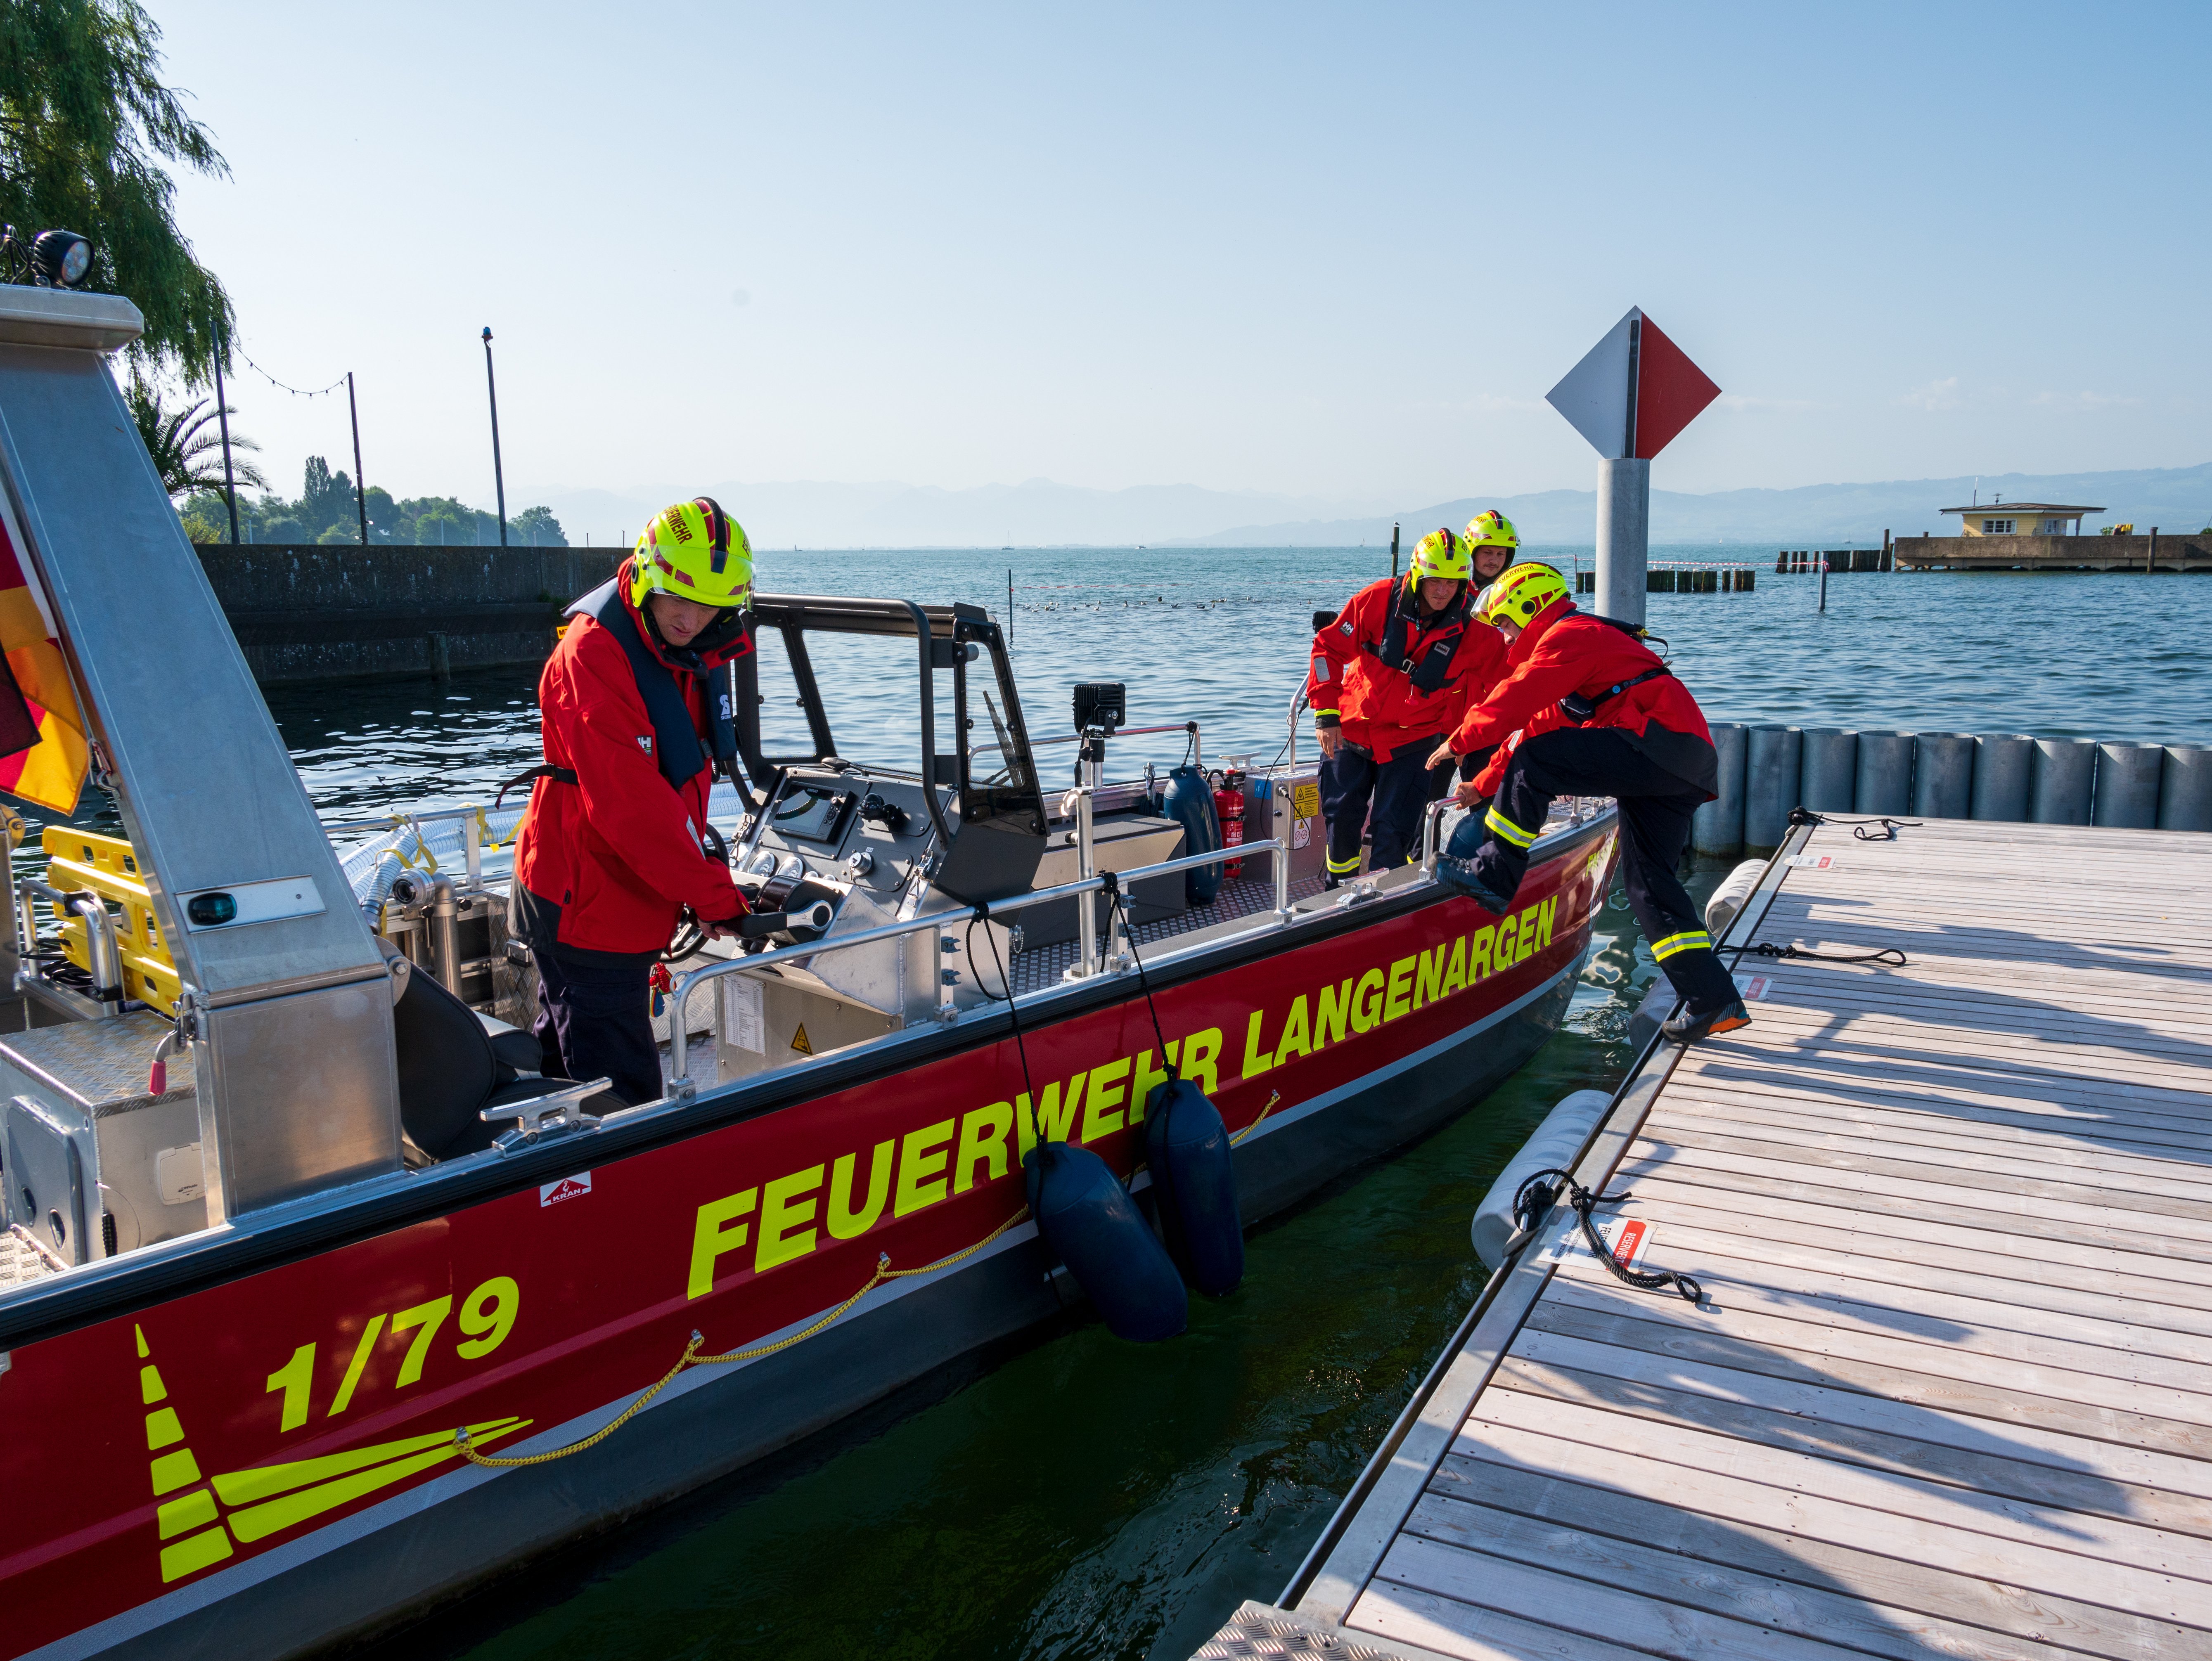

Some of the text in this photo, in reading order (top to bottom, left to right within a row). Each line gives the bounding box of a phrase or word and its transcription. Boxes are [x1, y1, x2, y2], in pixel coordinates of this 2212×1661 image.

[687, 895, 1557, 1300] FEUERWEHR LANGENARGEN
[553, 1188, 581, 1202] KRAN
[1615, 1232, 1637, 1263] RESERVIERT
[266, 1277, 519, 1432] 1/79
